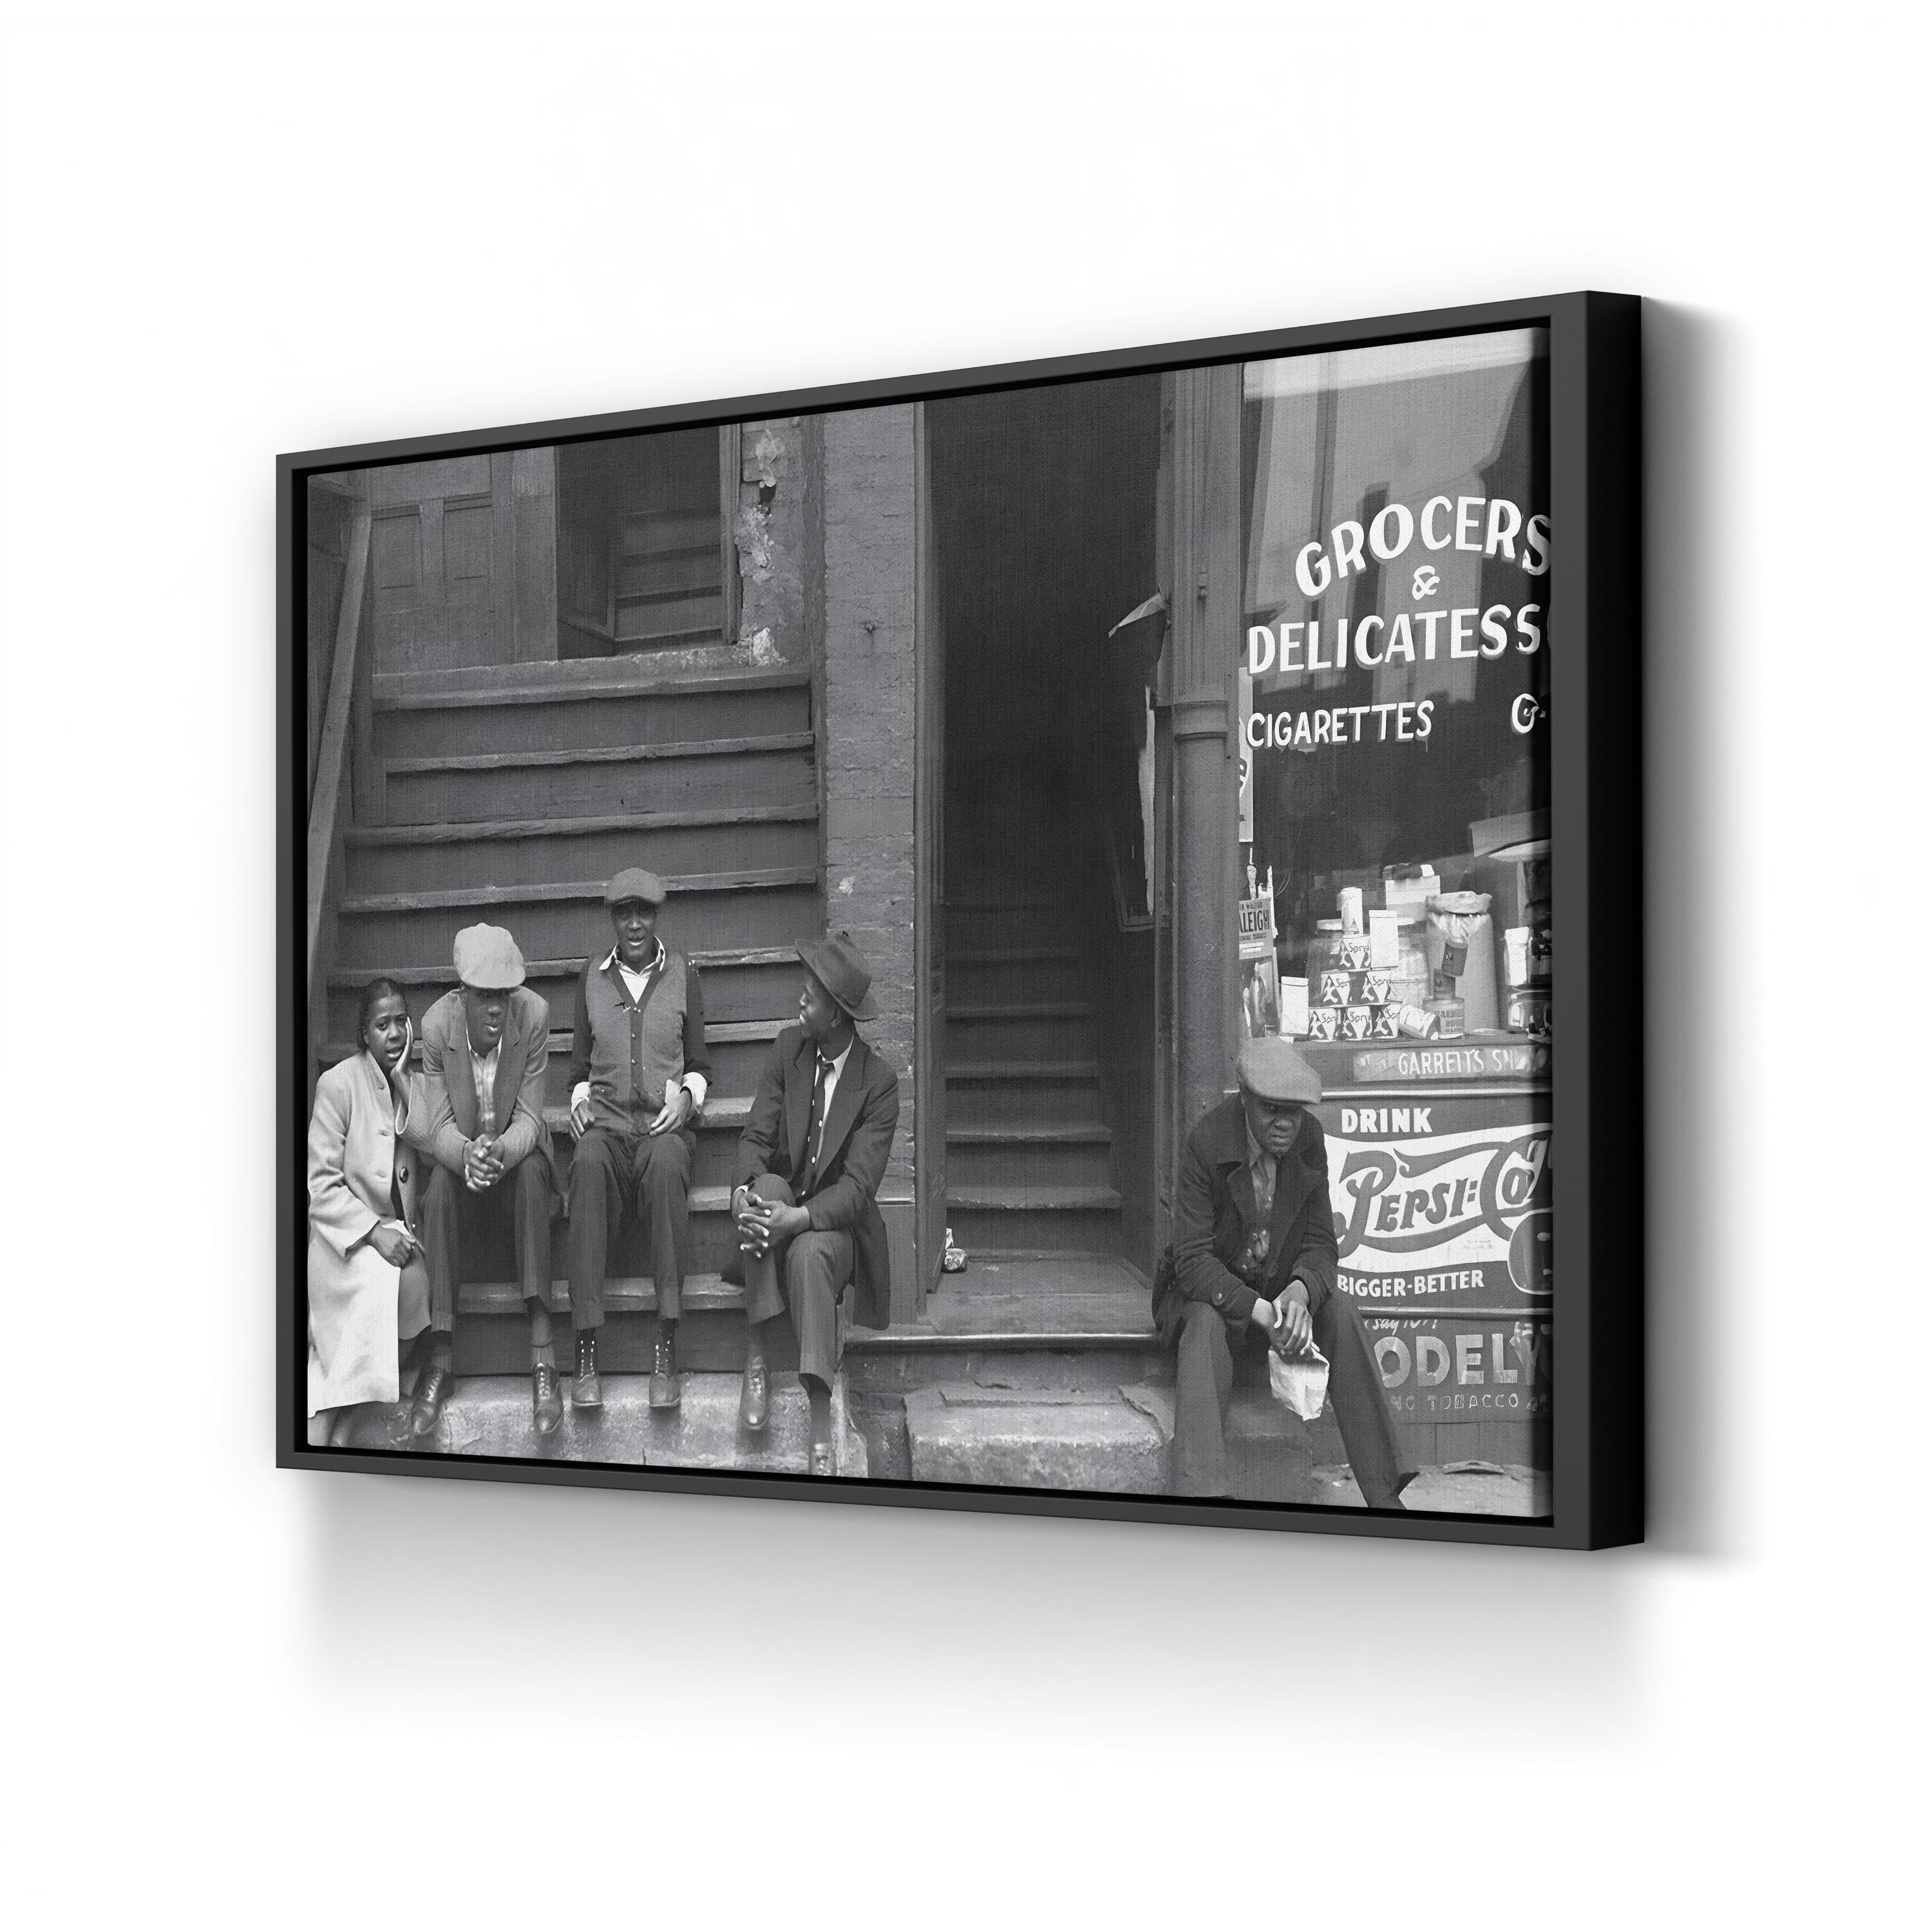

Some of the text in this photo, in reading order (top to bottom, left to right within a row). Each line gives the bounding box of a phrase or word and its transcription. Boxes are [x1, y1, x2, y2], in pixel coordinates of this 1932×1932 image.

[1412, 565, 1440, 600] &
[1249, 603, 1551, 674] DELICATESS
[1247, 700, 1434, 747] CIGARETTES
[1341, 1108, 1433, 1133] DRINK
[1337, 1269, 1484, 1298] BIGGER-BETTER
[1374, 1333, 1518, 1388] ODEL
